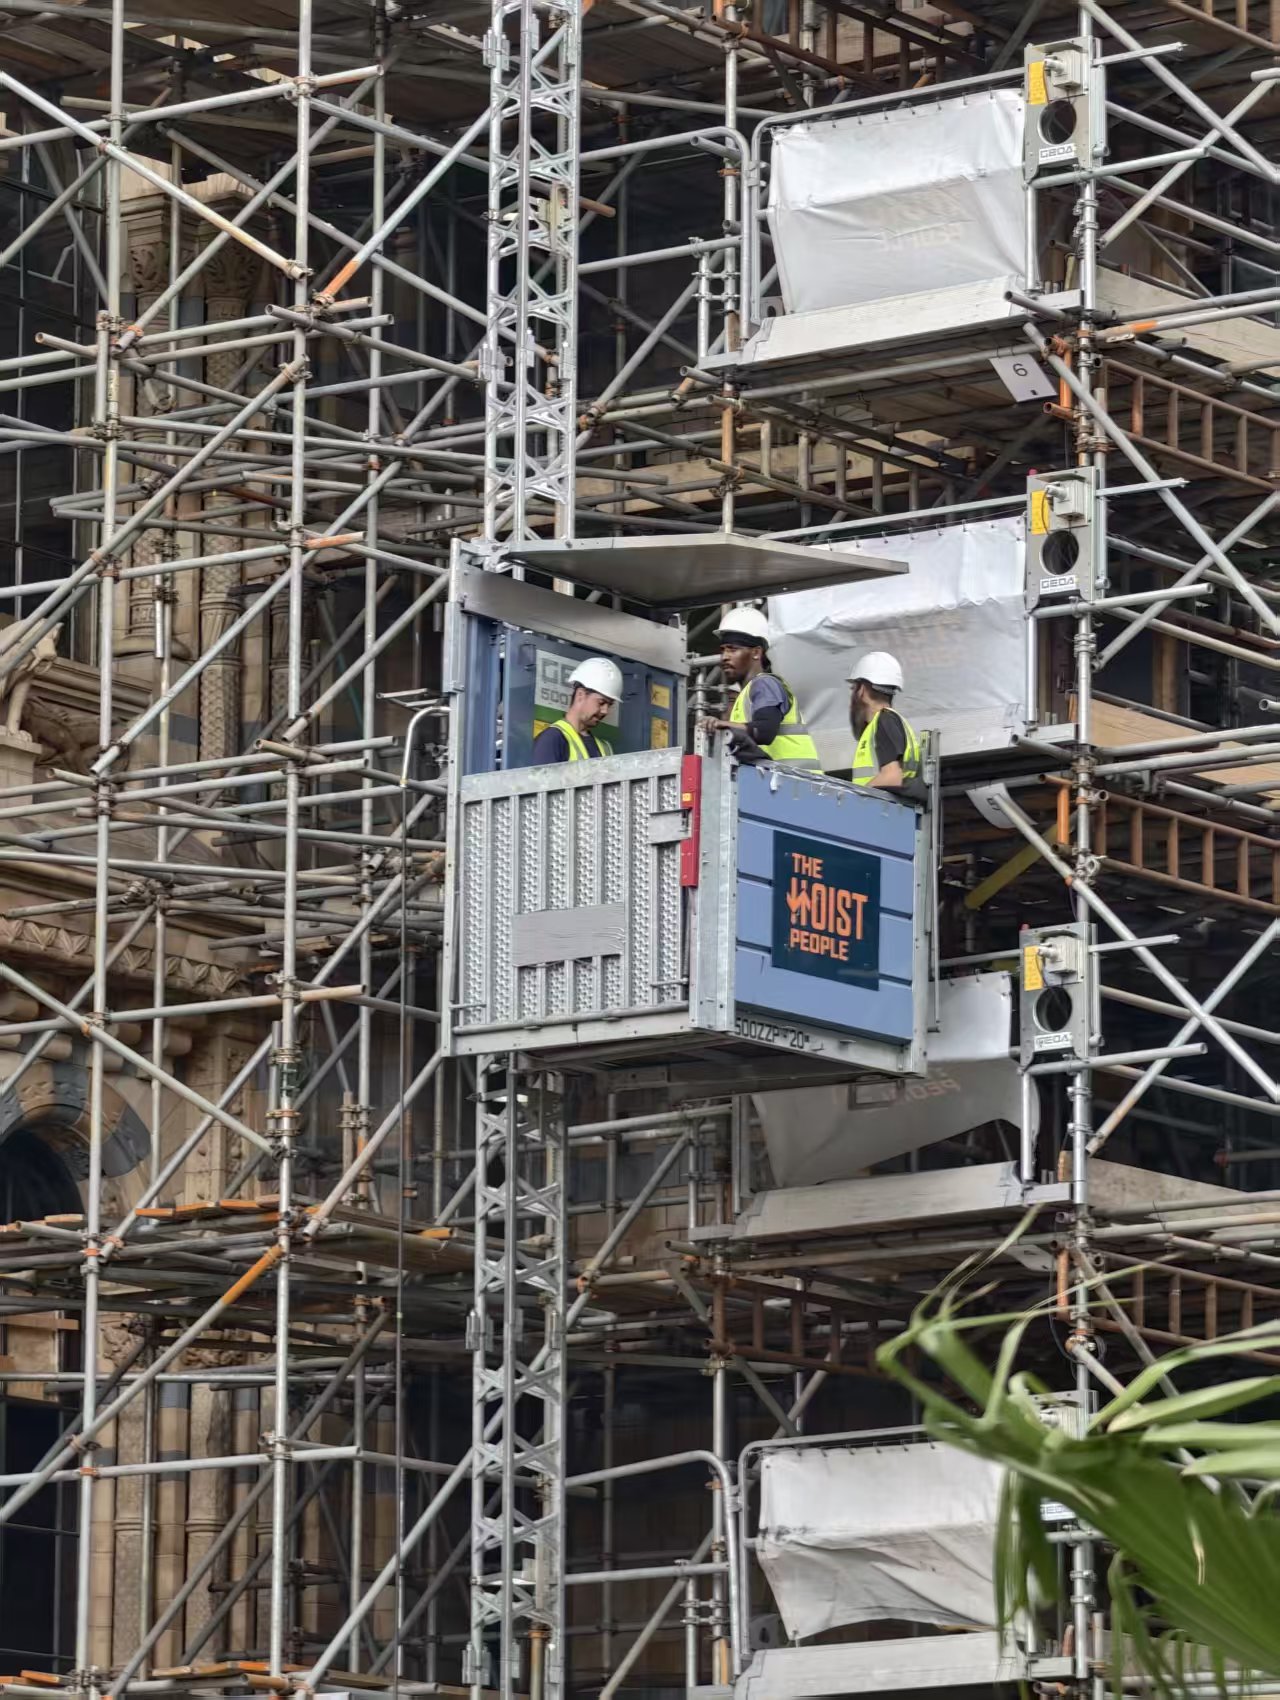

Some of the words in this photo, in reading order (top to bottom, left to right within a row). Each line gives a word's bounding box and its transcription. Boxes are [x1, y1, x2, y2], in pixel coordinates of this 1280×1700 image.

[1040, 146, 1073, 158] GEDA
[1013, 363, 1027, 377] 6
[1041, 577, 1075, 589] GEDA
[541, 657, 577, 688] GE
[792, 852, 824, 879] THE
[786, 876, 869, 941] HOIST
[789, 927, 849, 961] PEOPLE
